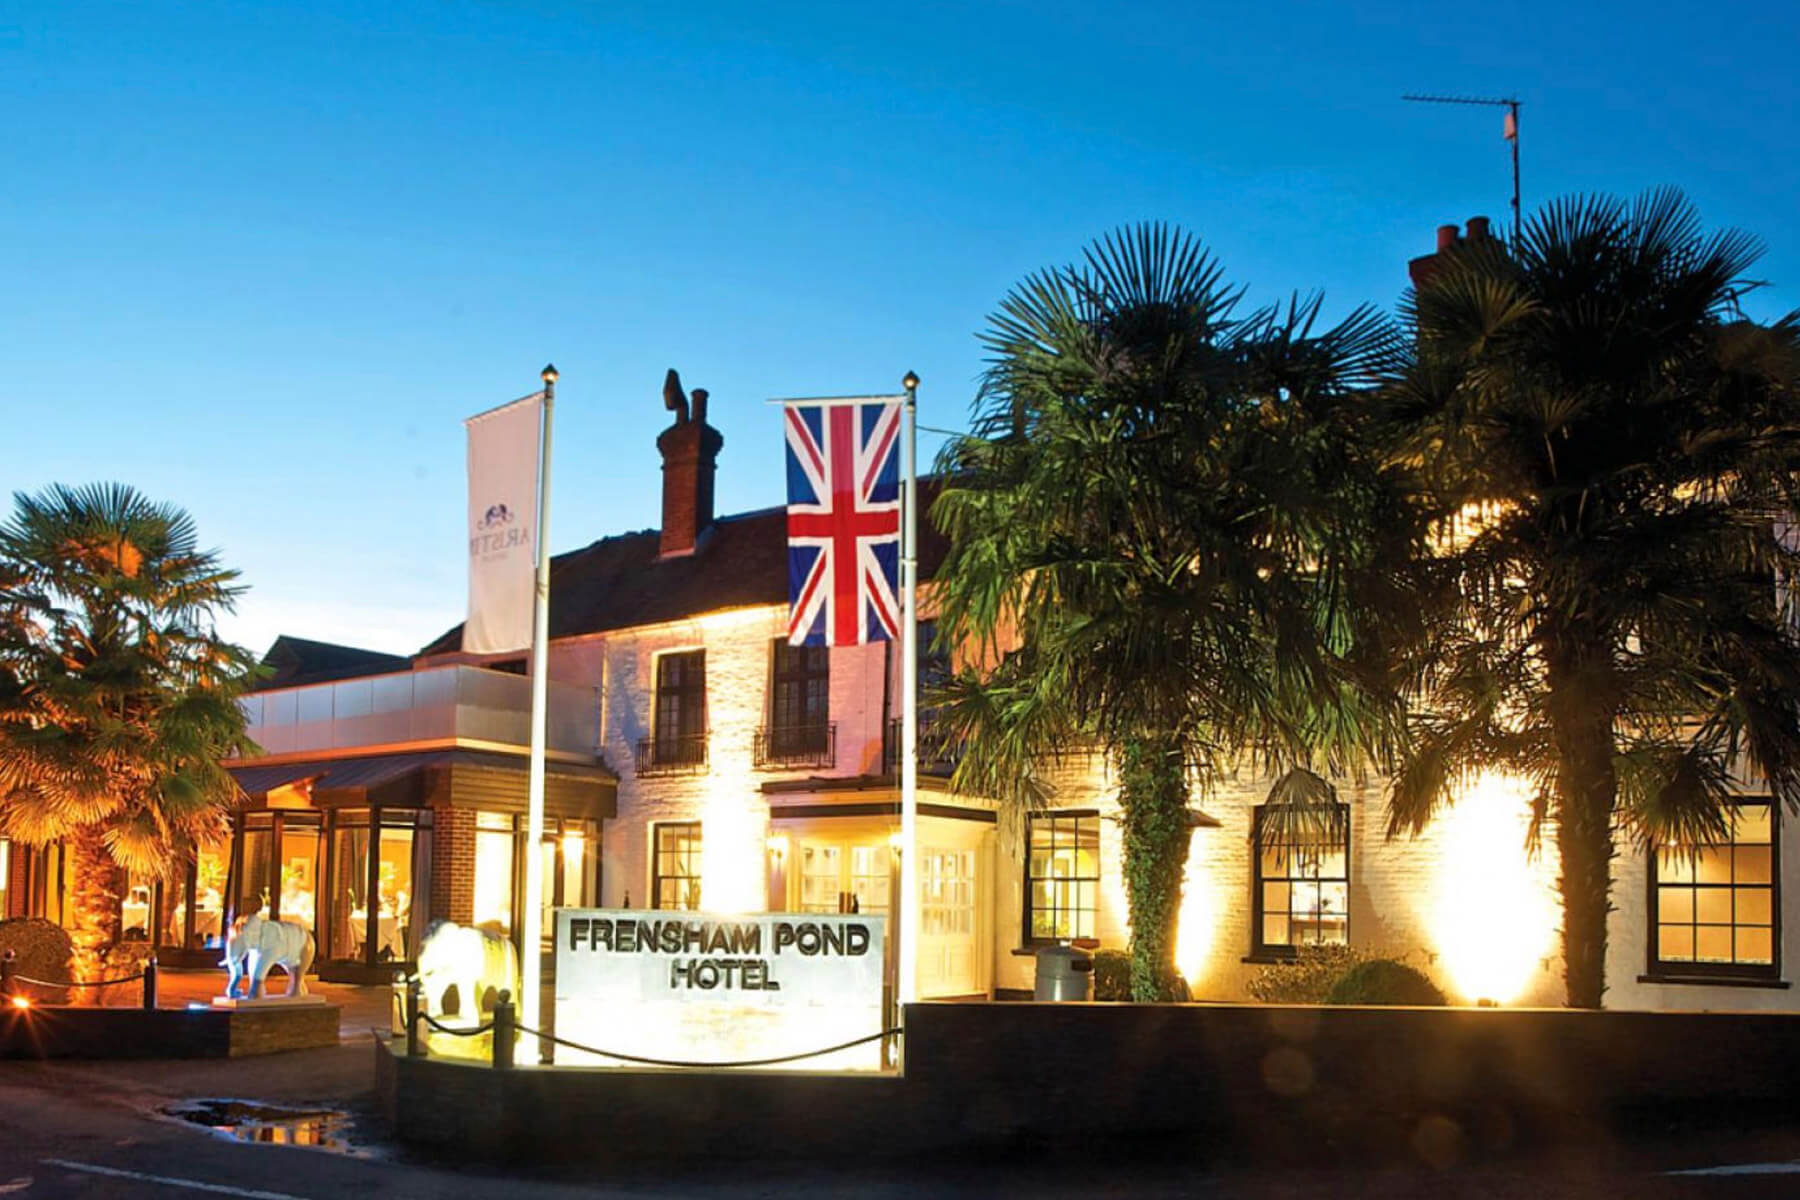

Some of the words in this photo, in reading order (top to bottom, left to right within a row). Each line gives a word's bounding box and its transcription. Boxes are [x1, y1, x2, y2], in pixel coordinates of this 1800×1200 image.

[569, 917, 761, 955] FRENSHAM
[773, 921, 871, 957] POND
[670, 957, 780, 991] HOTEL
